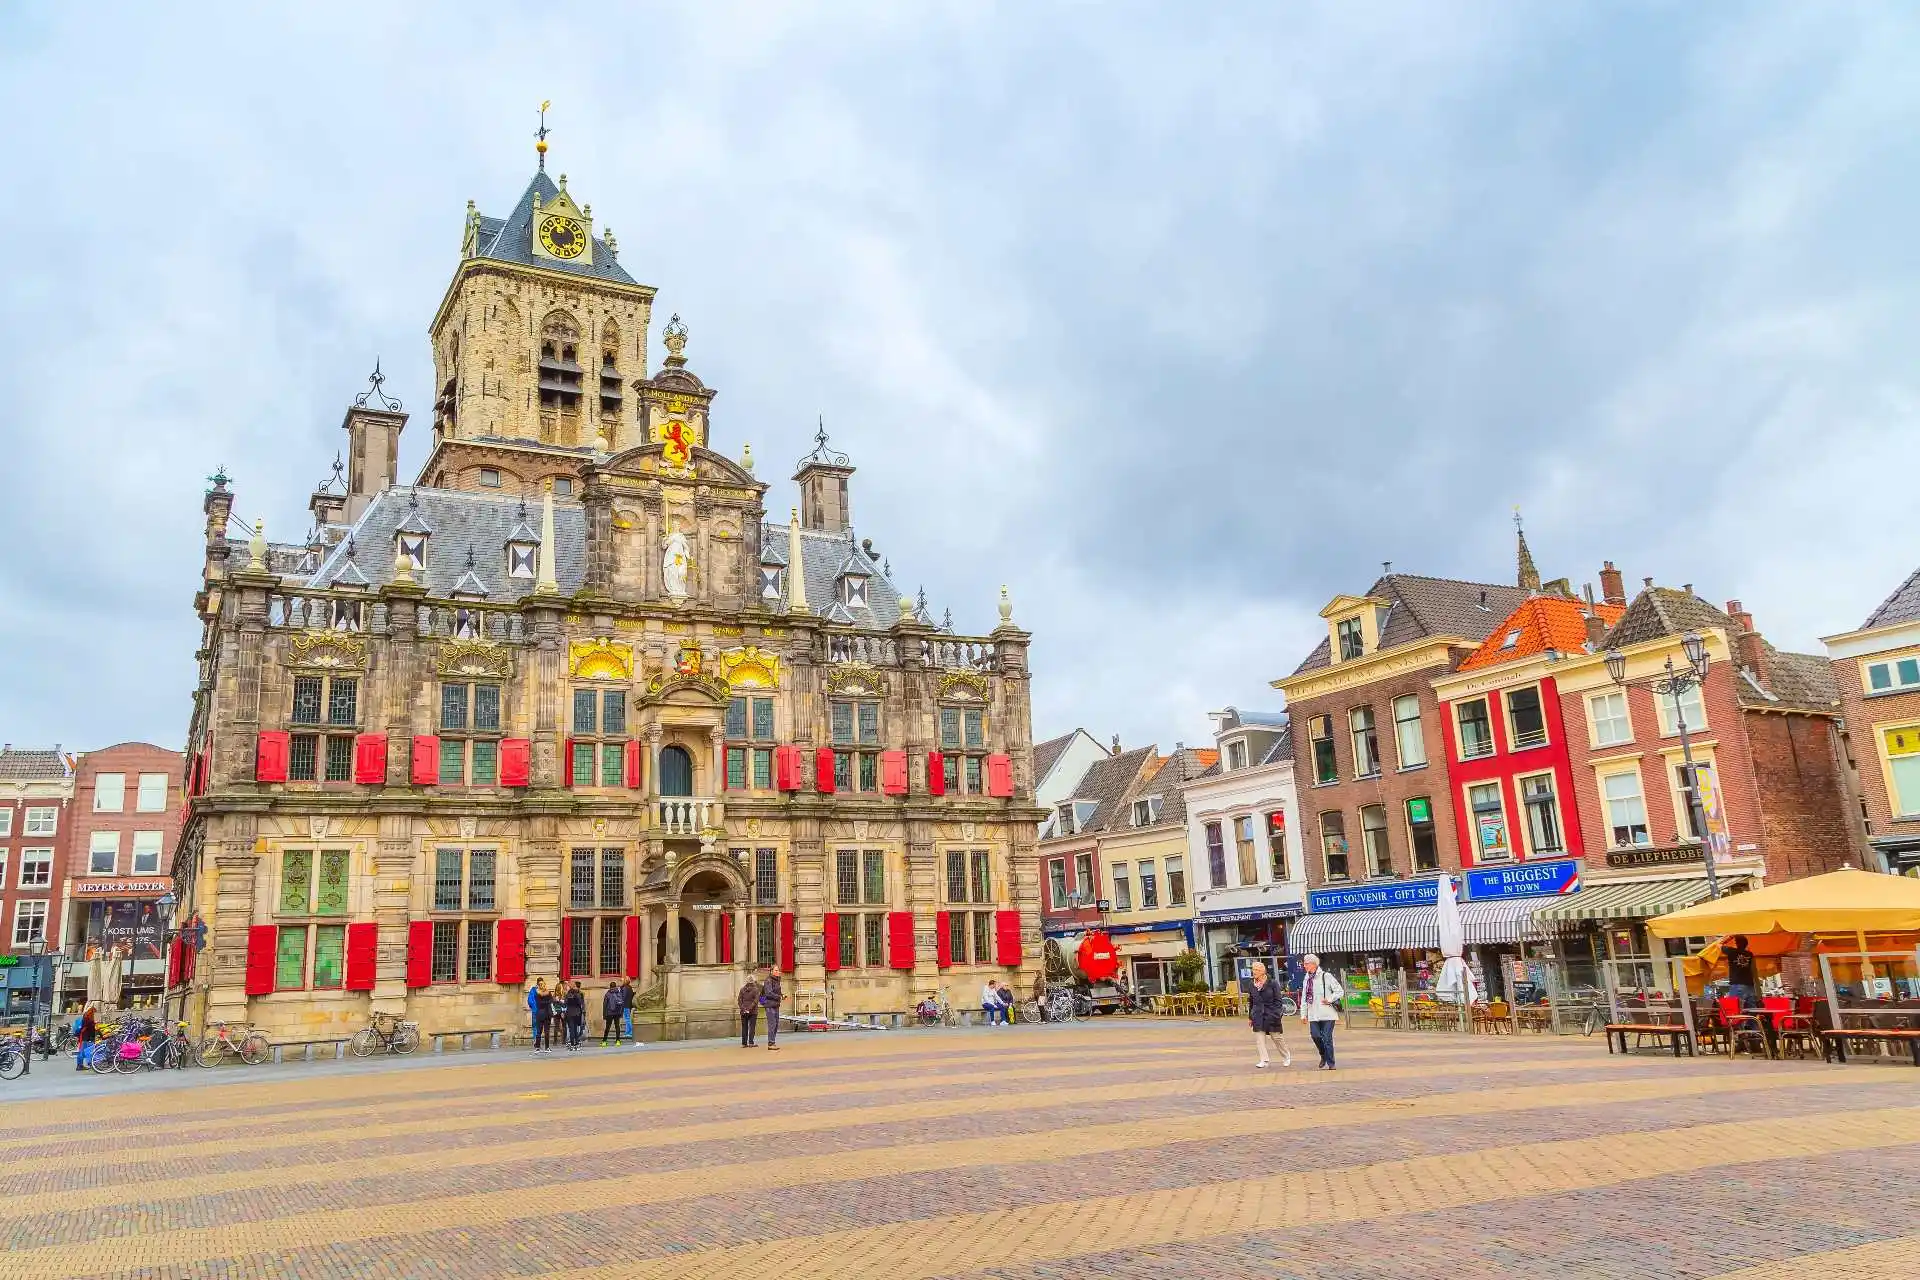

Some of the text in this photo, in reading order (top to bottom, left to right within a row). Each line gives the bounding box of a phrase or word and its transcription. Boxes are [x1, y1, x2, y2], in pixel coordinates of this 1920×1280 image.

[1613, 848, 1704, 864] DE LIEFHEBBE
[1483, 867, 1558, 886] THE BIGGEST
[77, 882, 165, 892] MEYER & MEYER
[1503, 883, 1540, 893] IN TOWN
[1316, 895, 1342, 907] DELFT
[1343, 891, 1388, 904] SOUVENIR
[1394, 888, 1416, 900] GIFT
[1418, 886, 1439, 898] SHO
